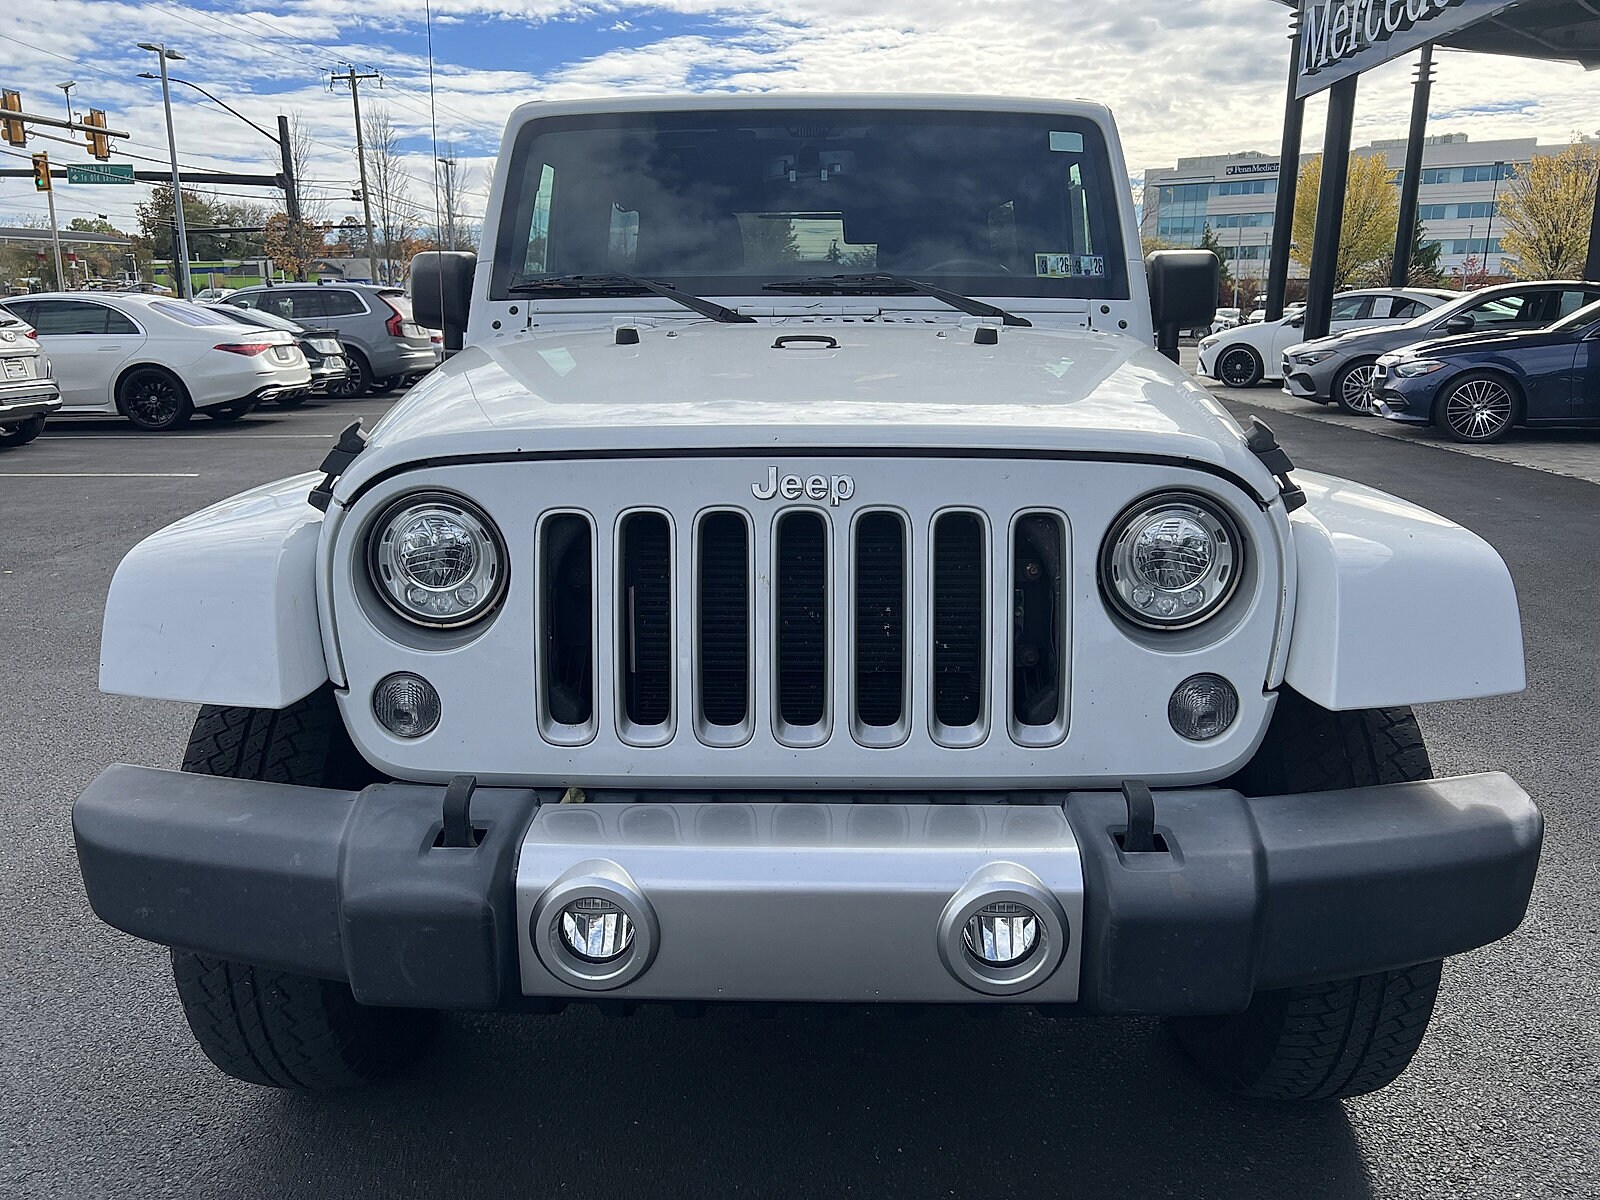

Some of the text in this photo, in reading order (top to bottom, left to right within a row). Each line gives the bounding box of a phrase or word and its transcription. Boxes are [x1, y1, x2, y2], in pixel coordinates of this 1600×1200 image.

[1300, 0, 1450, 75] Merce
[1234, 166, 1251, 174] Penn
[1060, 256, 1069, 273] 26
[1093, 257, 1103, 274] 26
[751, 465, 855, 507] Jeep
